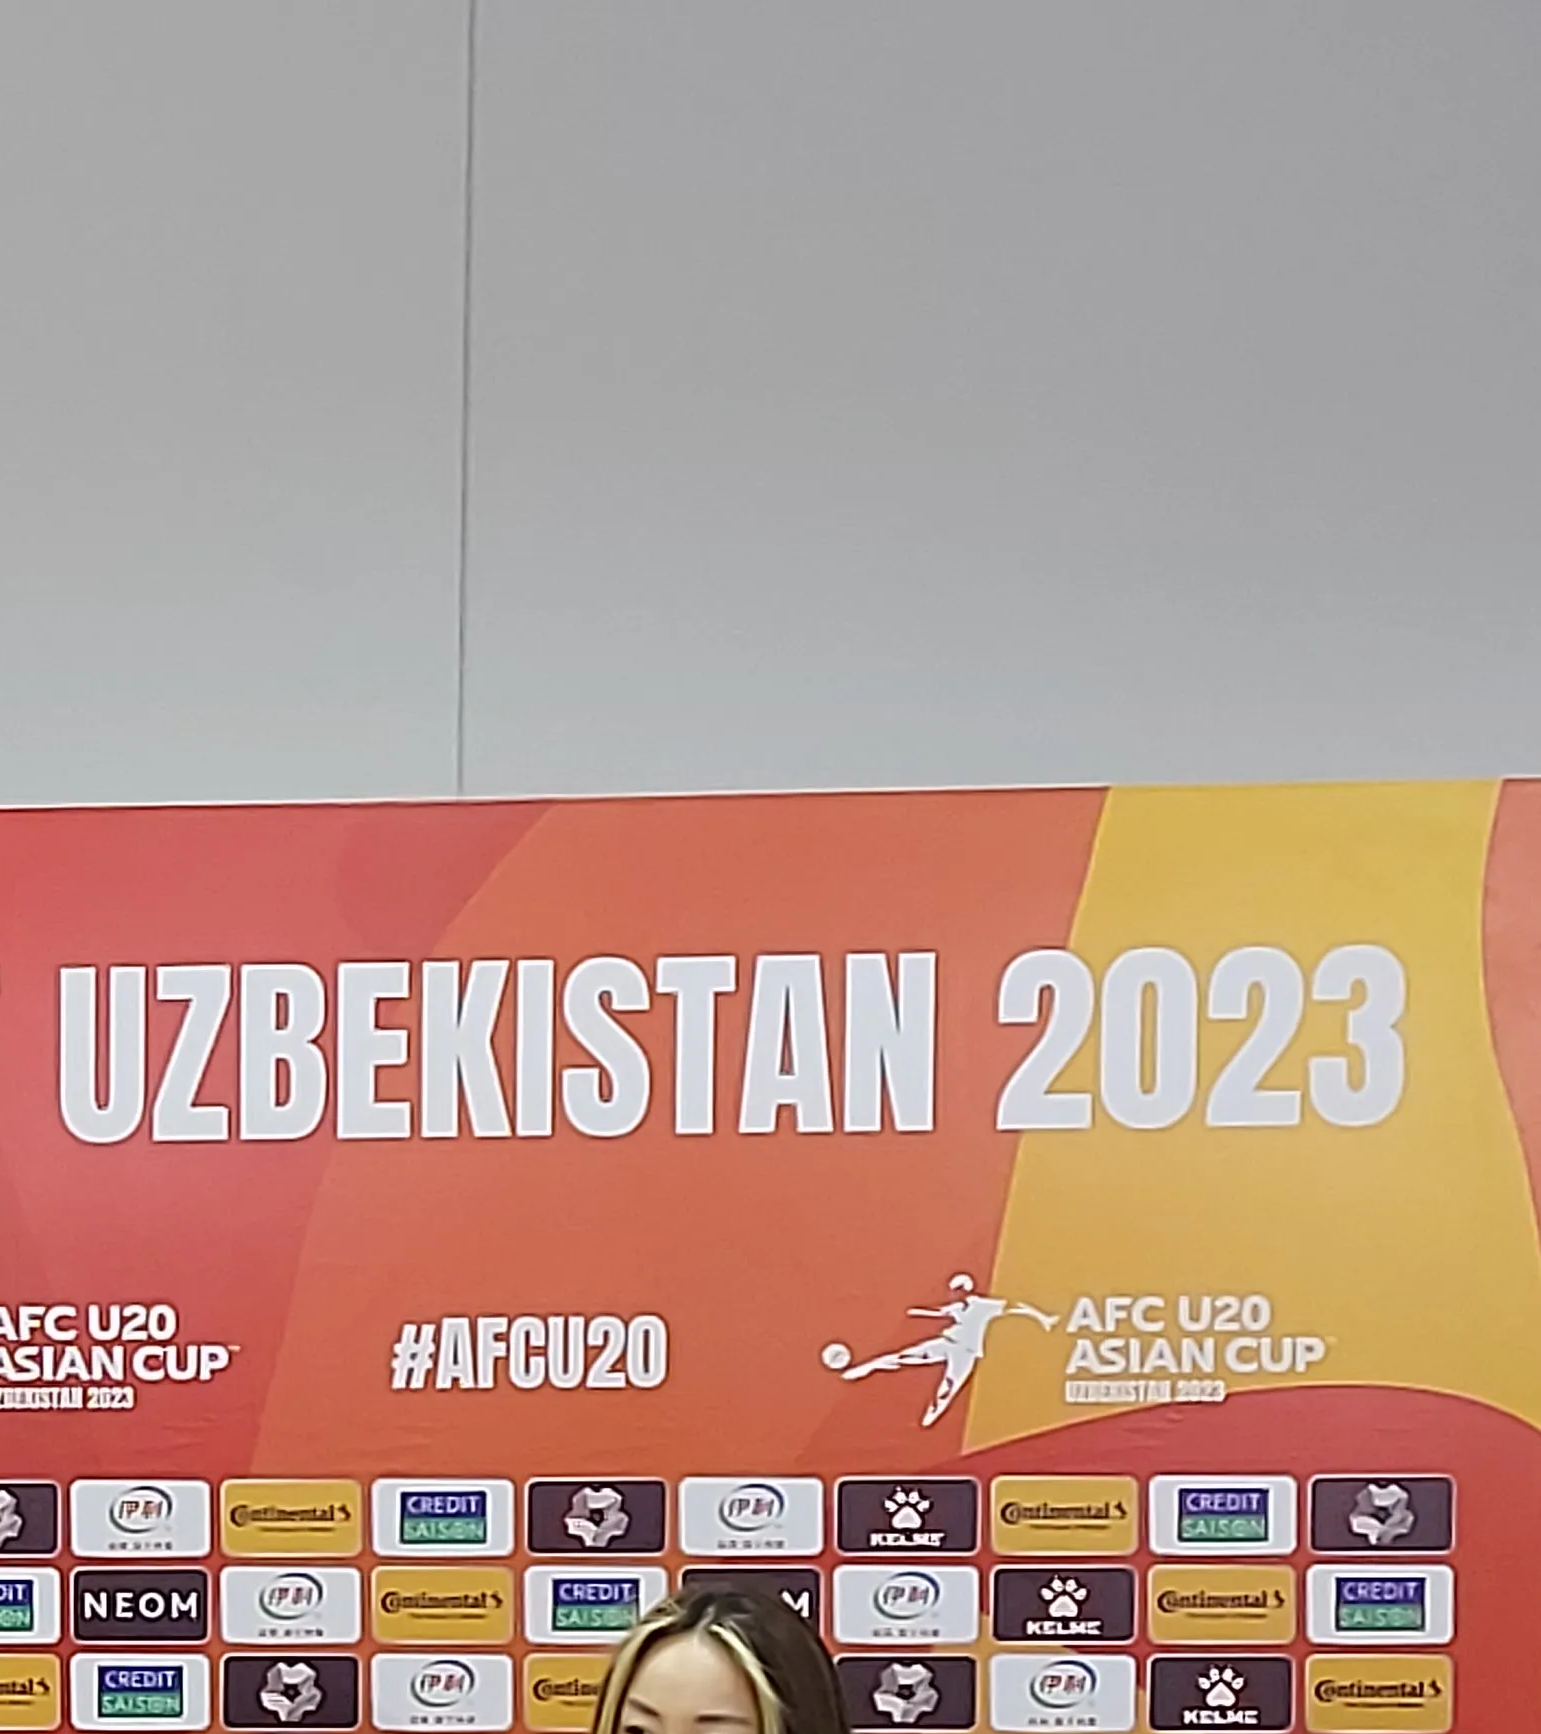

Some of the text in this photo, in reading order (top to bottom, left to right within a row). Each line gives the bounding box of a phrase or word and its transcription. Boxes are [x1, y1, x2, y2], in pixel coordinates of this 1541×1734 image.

[61, 953, 935, 1143] UZBEKISTAN
[997, 945, 1405, 1129] 2023
[88, 1304, 177, 1341] U20
[1066, 1295, 1270, 1332] AFC U20
[132, 1345, 230, 1381] CUP
[392, 1316, 666, 1388] #AFCU20
[1066, 1336, 1325, 1374] ASIAN CUP
[407, 1496, 480, 1515] CREDIT
[1185, 1493, 1262, 1513] CREDIT
[85, 1592, 197, 1618] NEOM
[559, 1583, 633, 1602] CREDIT
[1343, 1582, 1419, 1602] CREDIT
[104, 1671, 177, 1690] CREDIT
